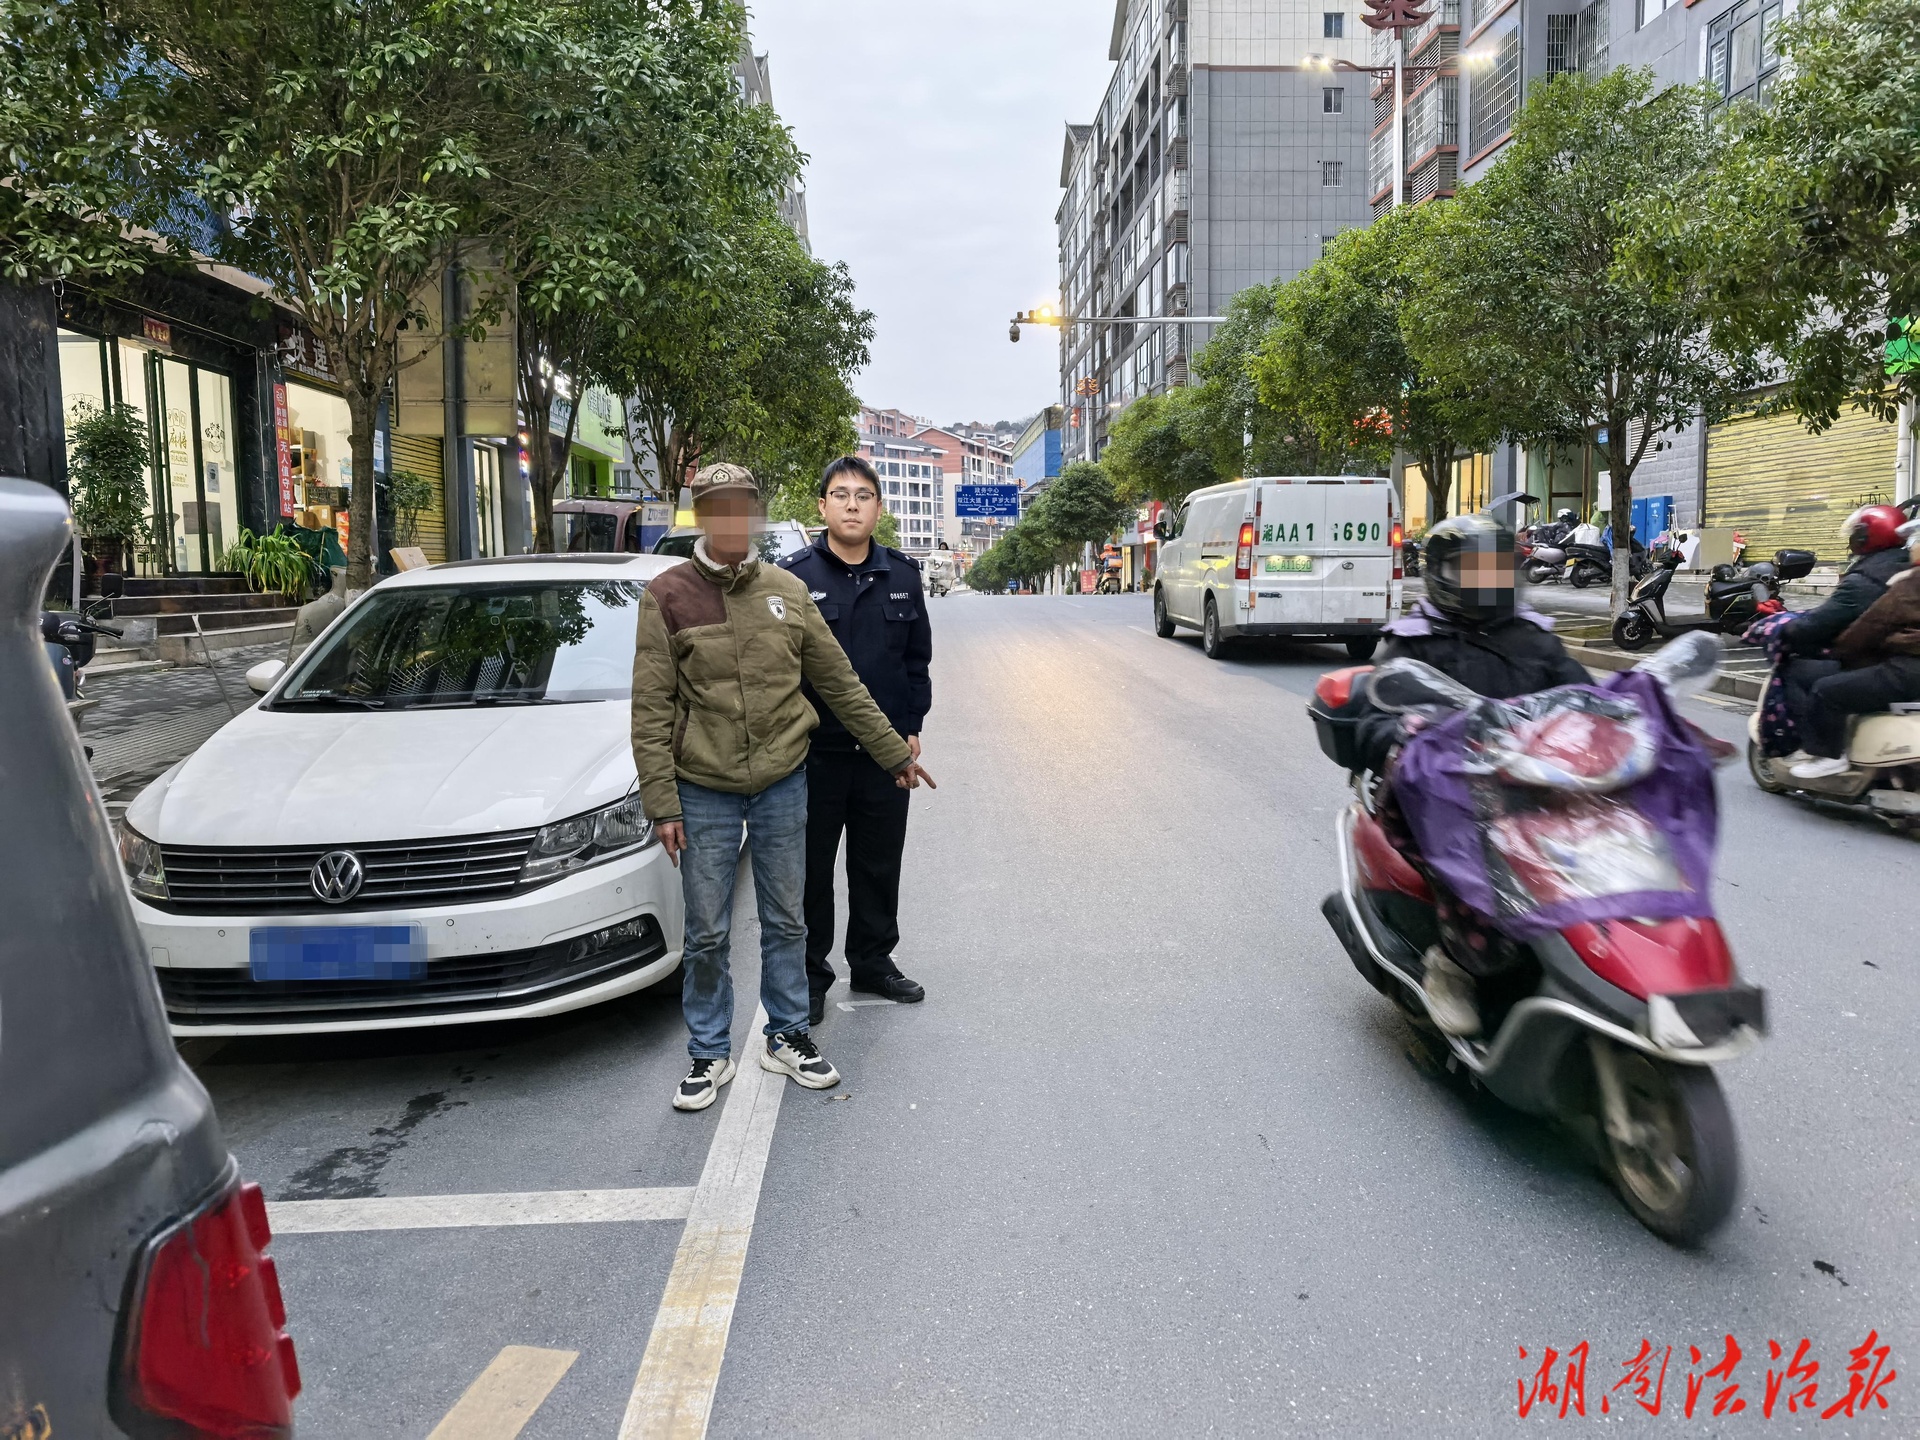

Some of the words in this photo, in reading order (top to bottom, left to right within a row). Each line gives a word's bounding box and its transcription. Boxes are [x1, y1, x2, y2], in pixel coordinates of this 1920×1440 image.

[280, 441, 291, 513] 无人值守驿站
